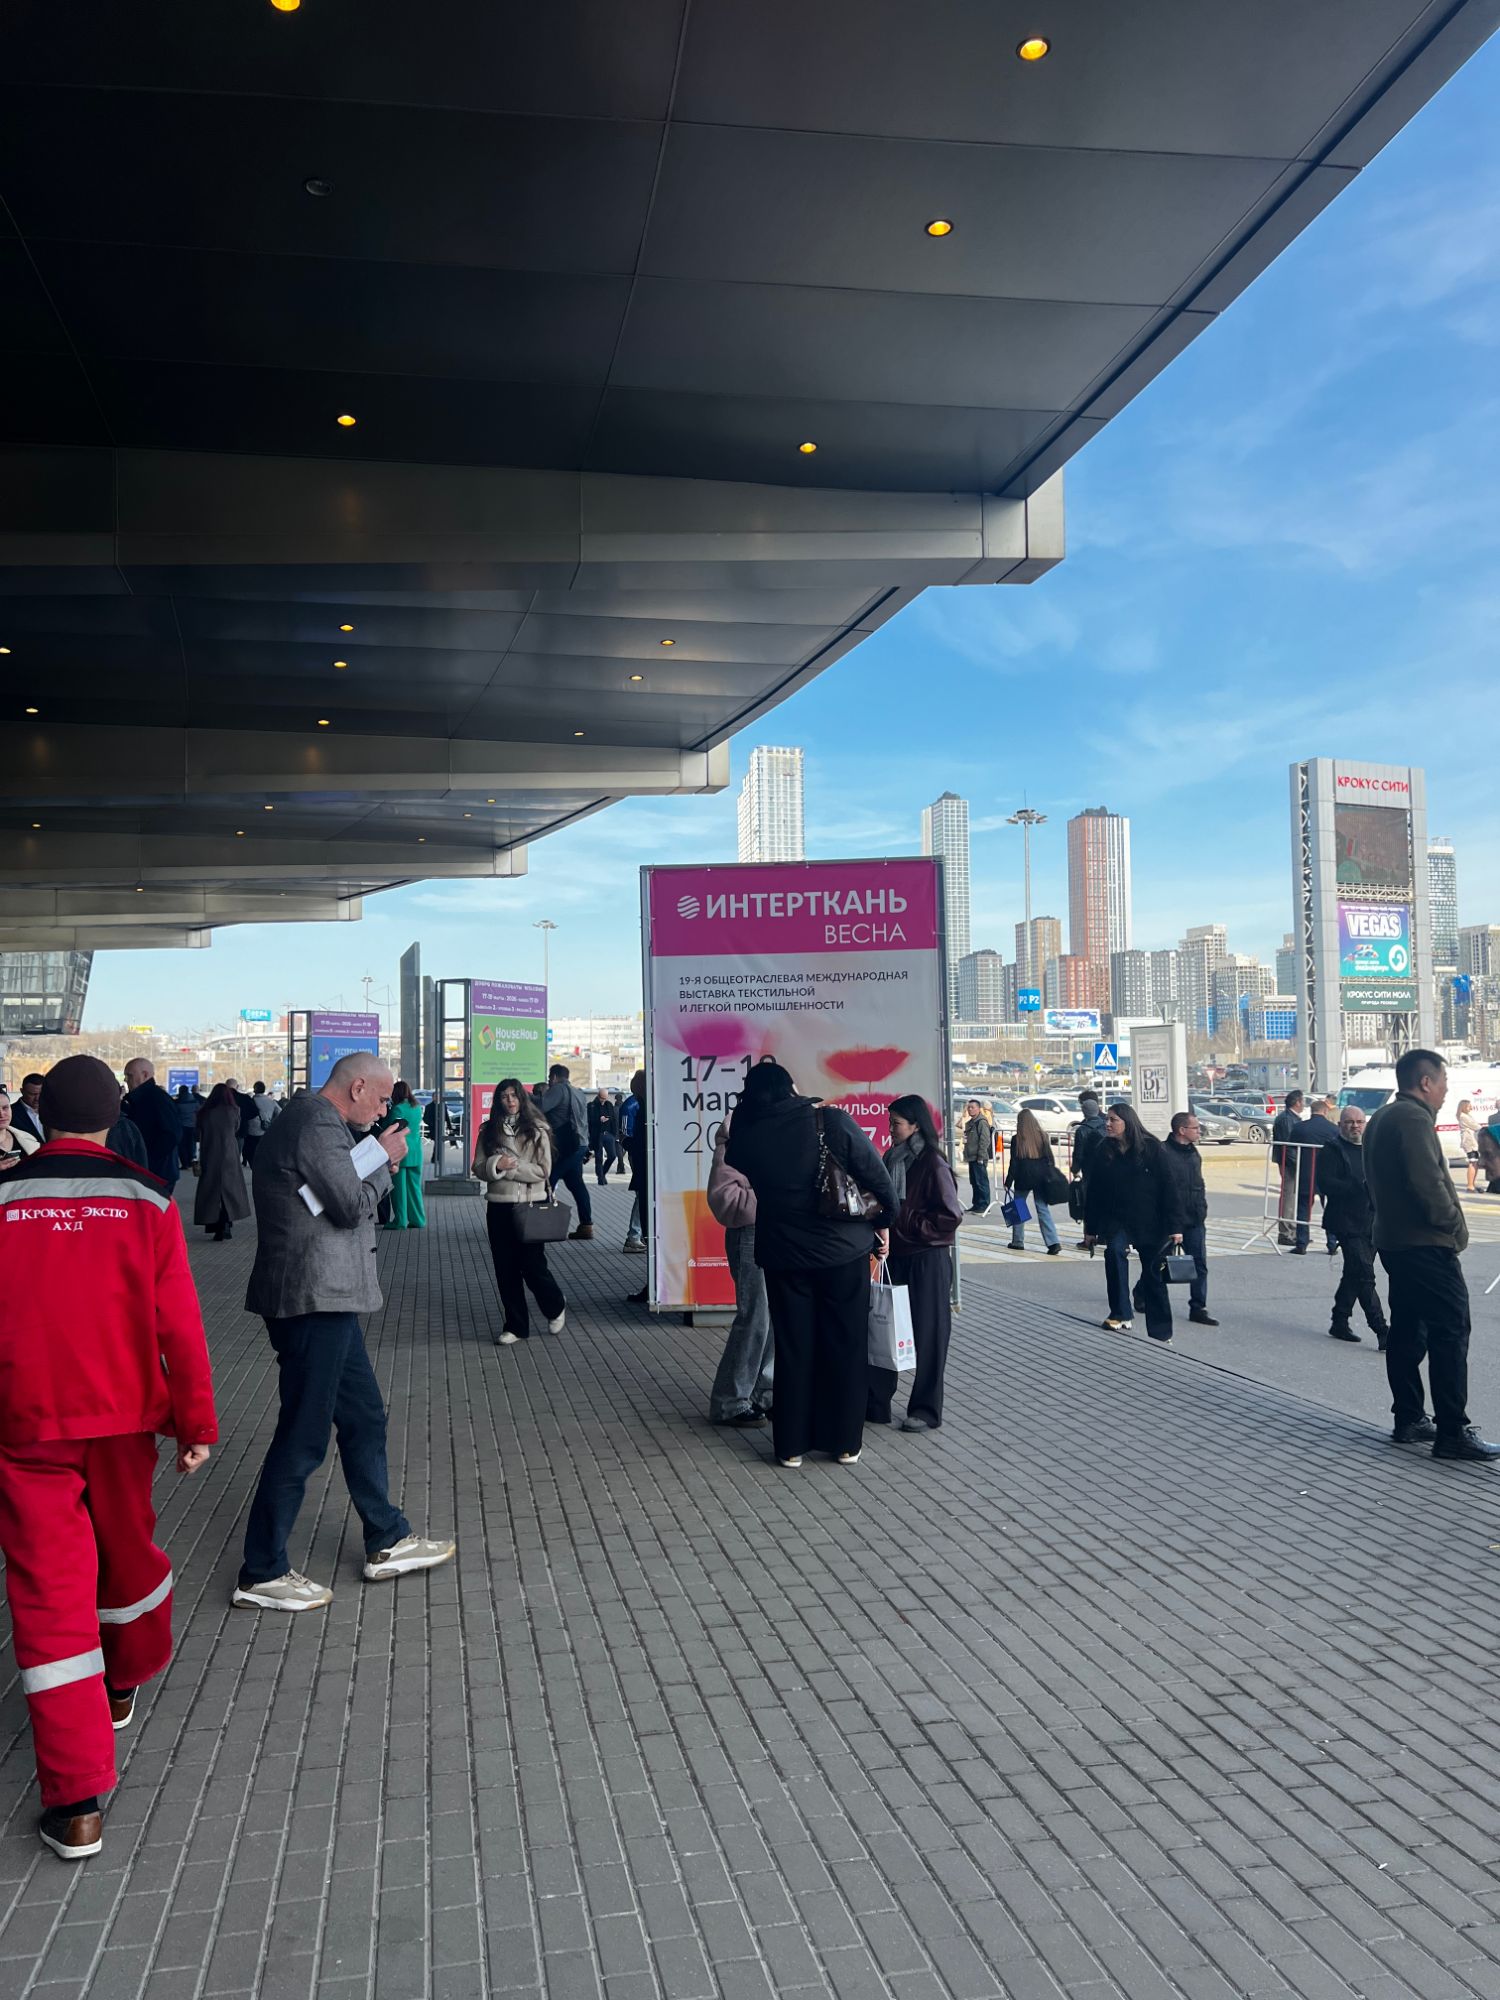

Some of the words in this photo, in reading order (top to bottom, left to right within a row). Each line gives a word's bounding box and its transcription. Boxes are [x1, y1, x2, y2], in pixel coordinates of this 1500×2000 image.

[1337, 776, 1379, 791] КРОКУС
[1381, 779, 1409, 793] СИТИ
[706, 888, 908, 920] ИНТЕРТКАНЬ
[1347, 913, 1401, 937] VEGAS
[824, 922, 907, 945] ВЕСНА
[679, 976, 701, 986] 19-Я
[703, 973, 804, 987] ОБЩЕОТРАСЛЕВАЯ
[806, 970, 909, 985] МЕЖДУНАРОДНАЯ
[680, 988, 736, 999] ВЫСТАВКА
[738, 986, 815, 998] ТЕКСТИЛЬНОЙ
[1392, 991, 1411, 999] МОЛЛ
[1019, 996, 1027, 1004] P2
[1029, 995, 1040, 1004] P2
[680, 1003, 688, 1013] И
[689, 1001, 731, 1013] ЛЕГКОЙ
[734, 1000, 844, 1013] ПРОМЫШЛЕННОСТИ
[495, 1039, 516, 1052] EXPO
[81, 1206, 128, 1219] ЭКСПО
[52, 1221, 84, 1232] АХД
